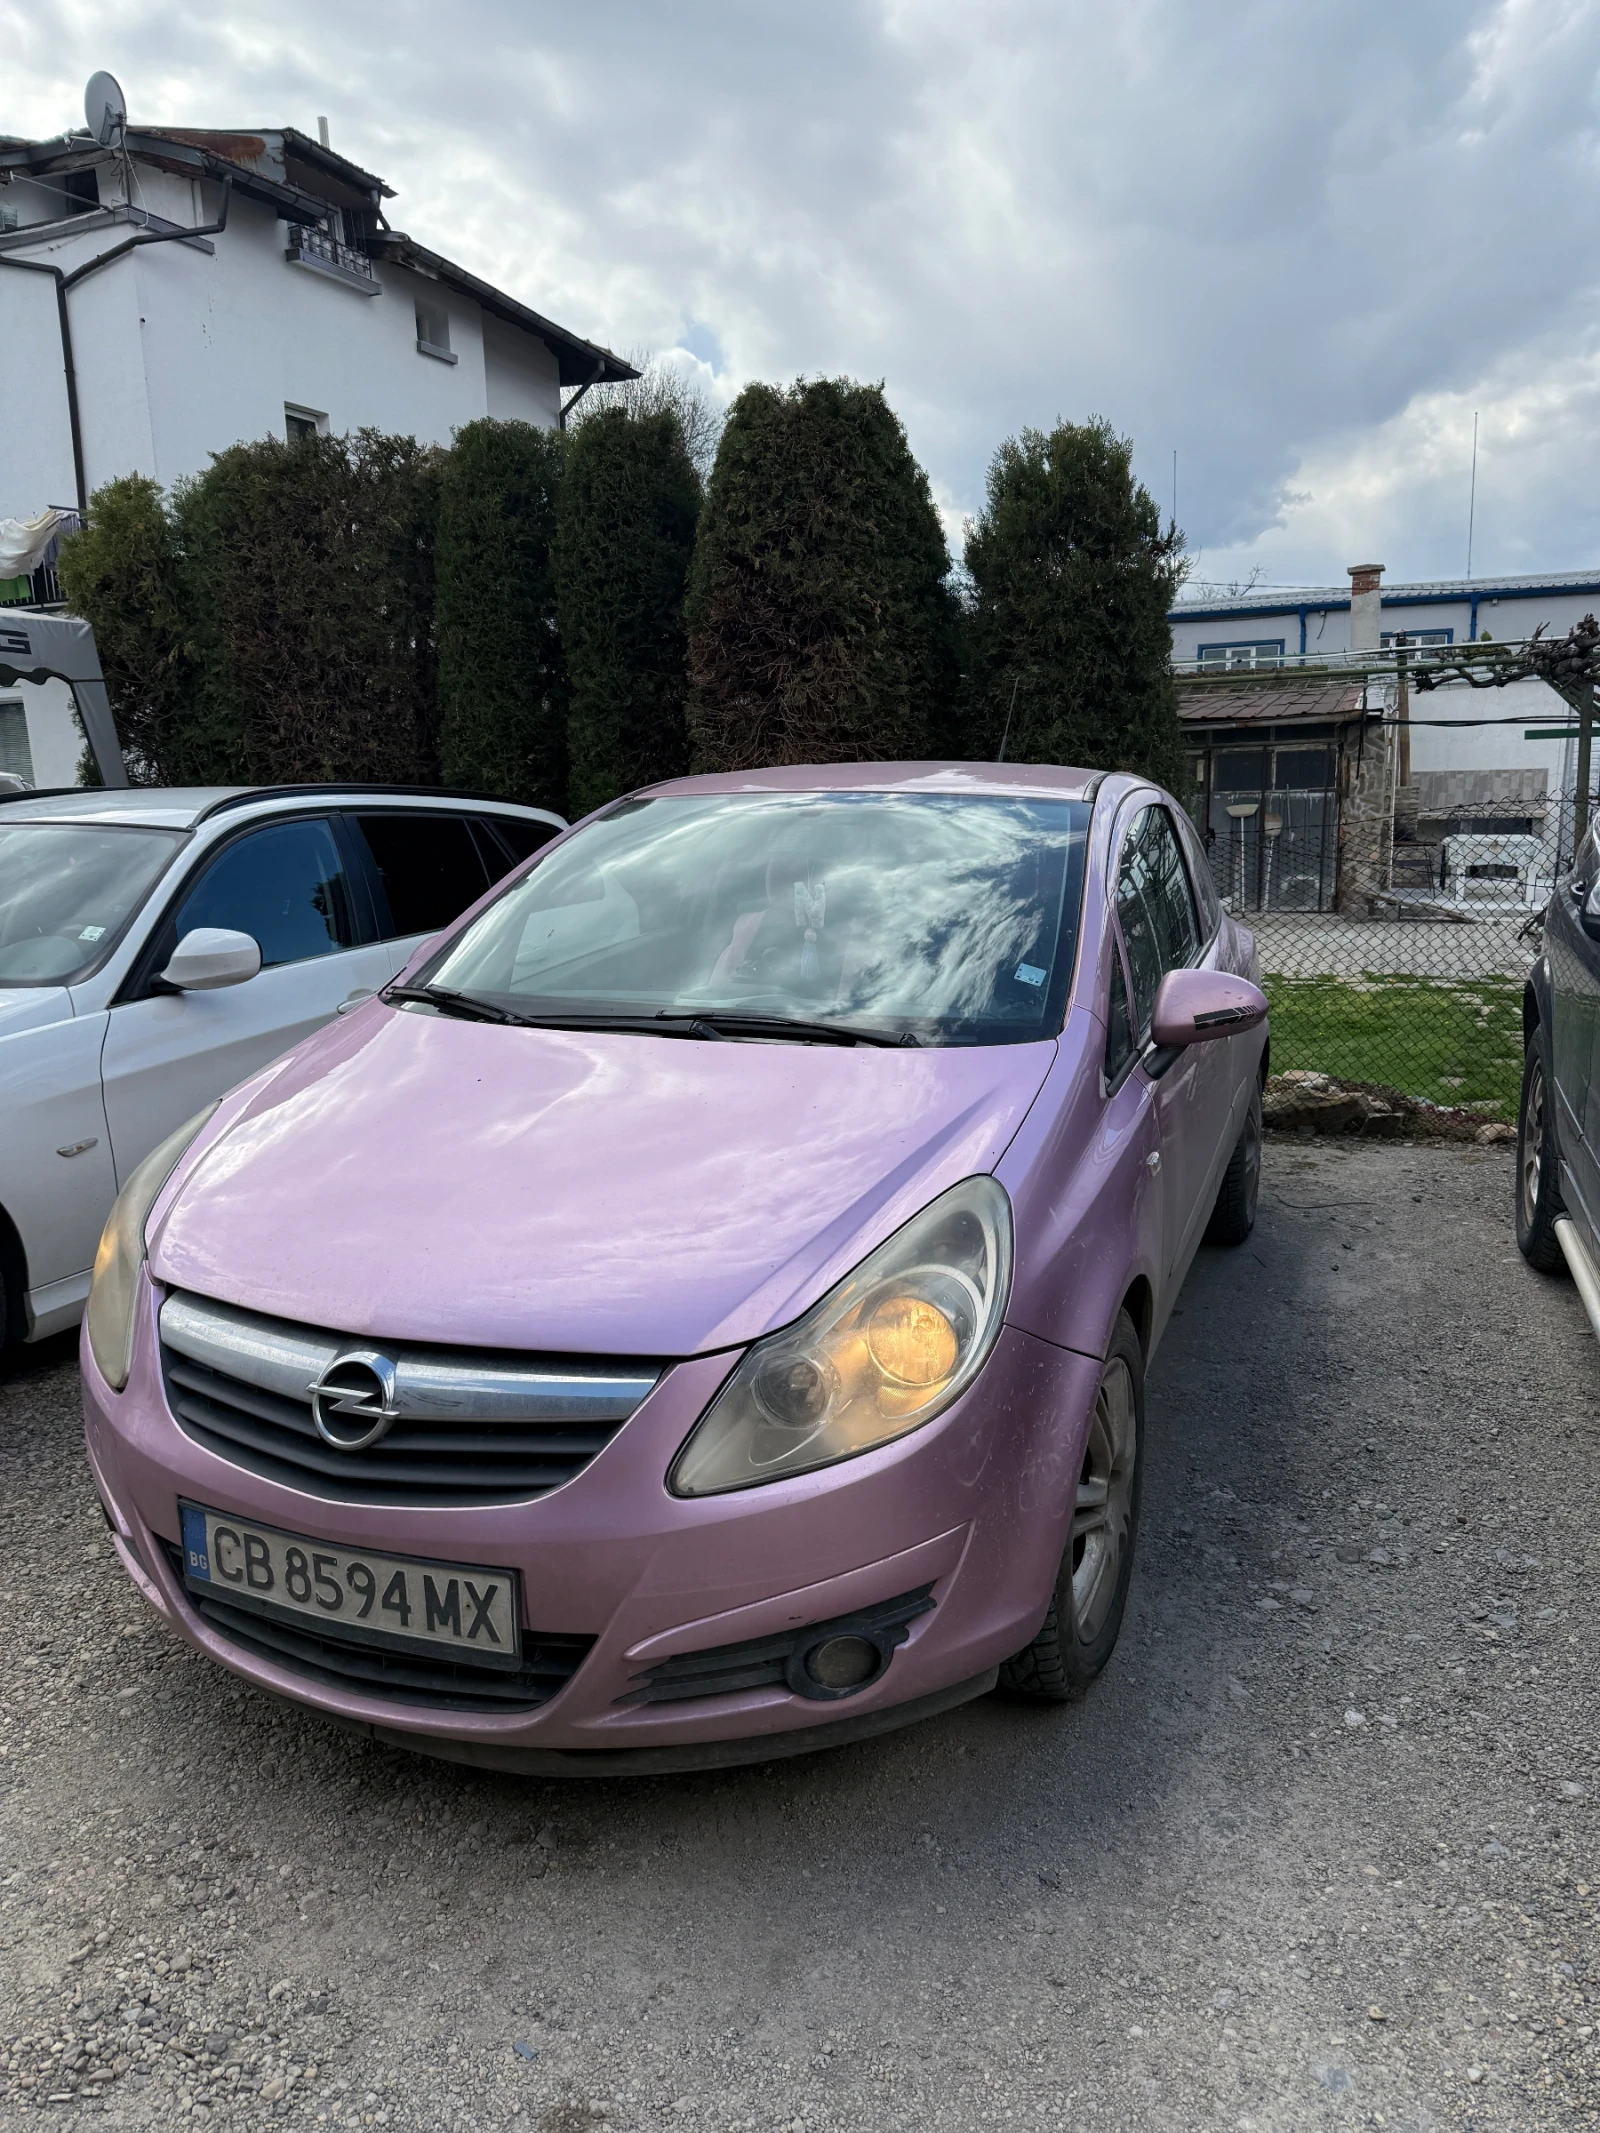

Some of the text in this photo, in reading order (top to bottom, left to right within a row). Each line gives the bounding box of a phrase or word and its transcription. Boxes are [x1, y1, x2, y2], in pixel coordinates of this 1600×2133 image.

[189, 1551, 208, 1571] BG
[214, 1526, 502, 1643] CB 8594 MX
